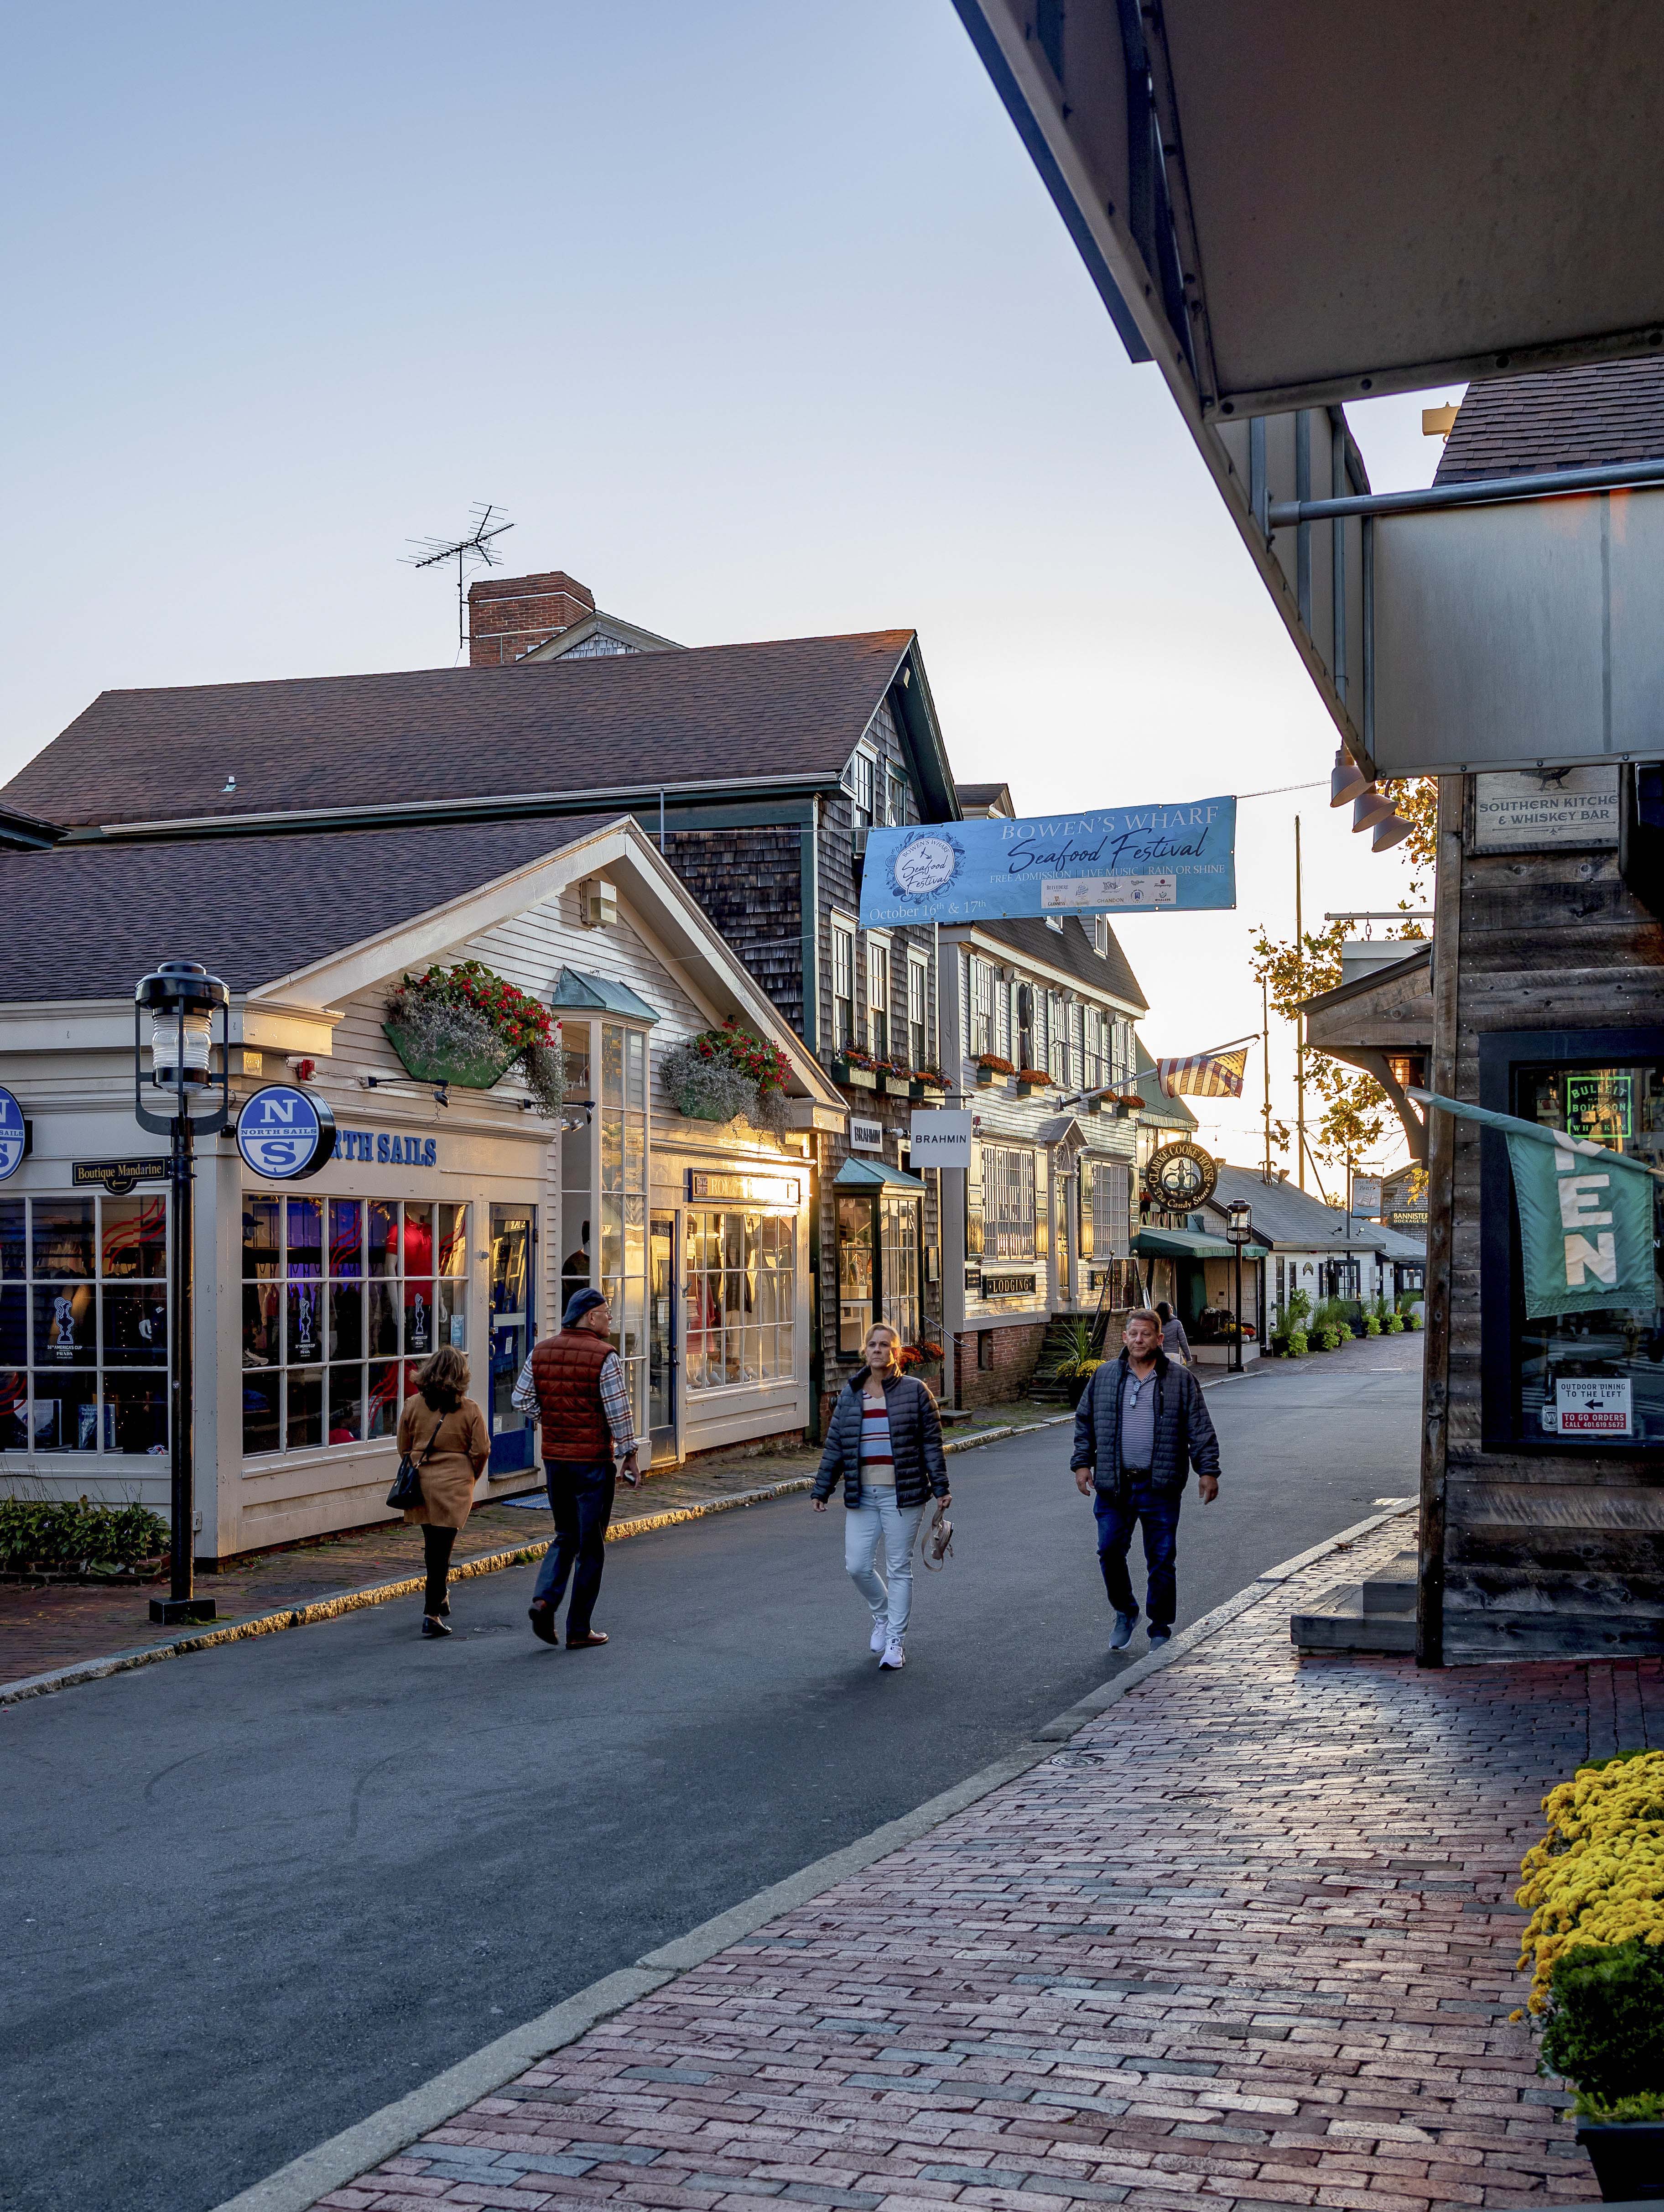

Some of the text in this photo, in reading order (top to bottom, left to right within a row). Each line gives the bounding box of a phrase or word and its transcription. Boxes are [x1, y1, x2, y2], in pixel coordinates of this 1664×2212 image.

[1479, 795, 1618, 812] SOUTHERN KITCHE
[1001, 806, 1219, 840] BOWEN'S WHARF
[1498, 809, 1610, 824] & WHISKEY BAR
[901, 839, 950, 858] BOWEN'S WHARF
[1008, 827, 1209, 874] Seafood Festival
[901, 855, 948, 878] Seafood
[990, 865, 1225, 883] FREE ADMISSION LIVE MUSIC RAIN OR SHINE
[905, 869, 951, 893] Festival
[869, 900, 986, 920] October 16th & 17th
[1571, 1085, 1627, 1099] BULLEIT
[260, 1099, 297, 1122] N
[854, 1126, 881, 1144] BRAHMIN
[915, 1135, 967, 1143] BRAHMIN
[260, 1141, 296, 1165] S
[331, 1130, 437, 1167] RTH SAILS
[78, 1164, 161, 1180] Boutique Mandarine
[1149, 1145, 1214, 1183] CLARKE COOKE HOUSE
[1154, 1188, 1209, 1210] The Candy Store
[993, 1278, 1028, 1292] LODGING
